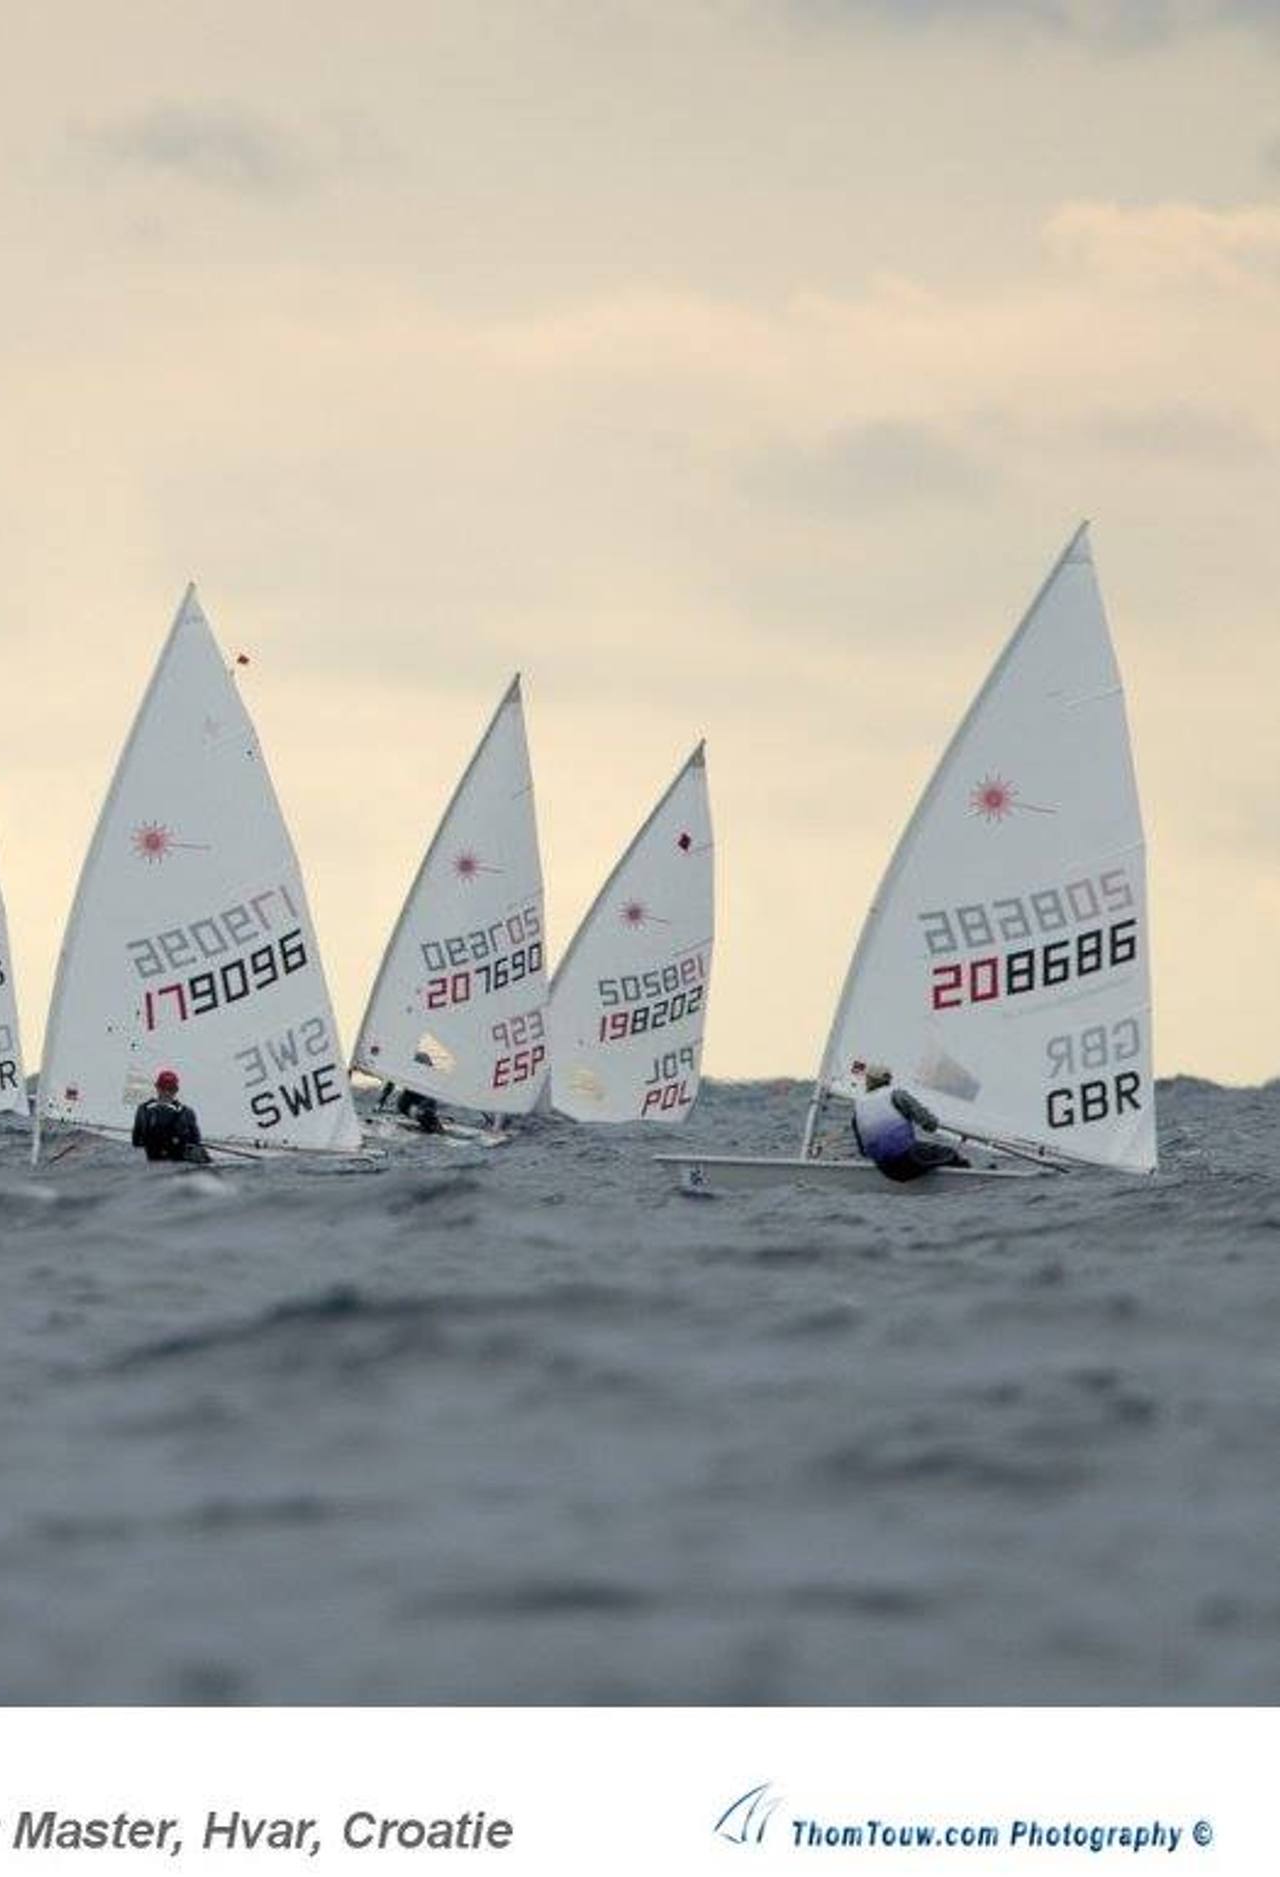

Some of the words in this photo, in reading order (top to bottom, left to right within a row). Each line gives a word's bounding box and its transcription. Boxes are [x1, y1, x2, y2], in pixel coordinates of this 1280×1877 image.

[145, 928, 308, 1031] 179096
[427, 943, 543, 1010] 207690
[932, 918, 1137, 1010] 208686
[599, 985, 703, 1042] 198202
[251, 1063, 342, 1128] SWE
[492, 1045, 545, 1088] ESP
[641, 1080, 692, 1116] POL
[1047, 1071, 1141, 1129] GBR
